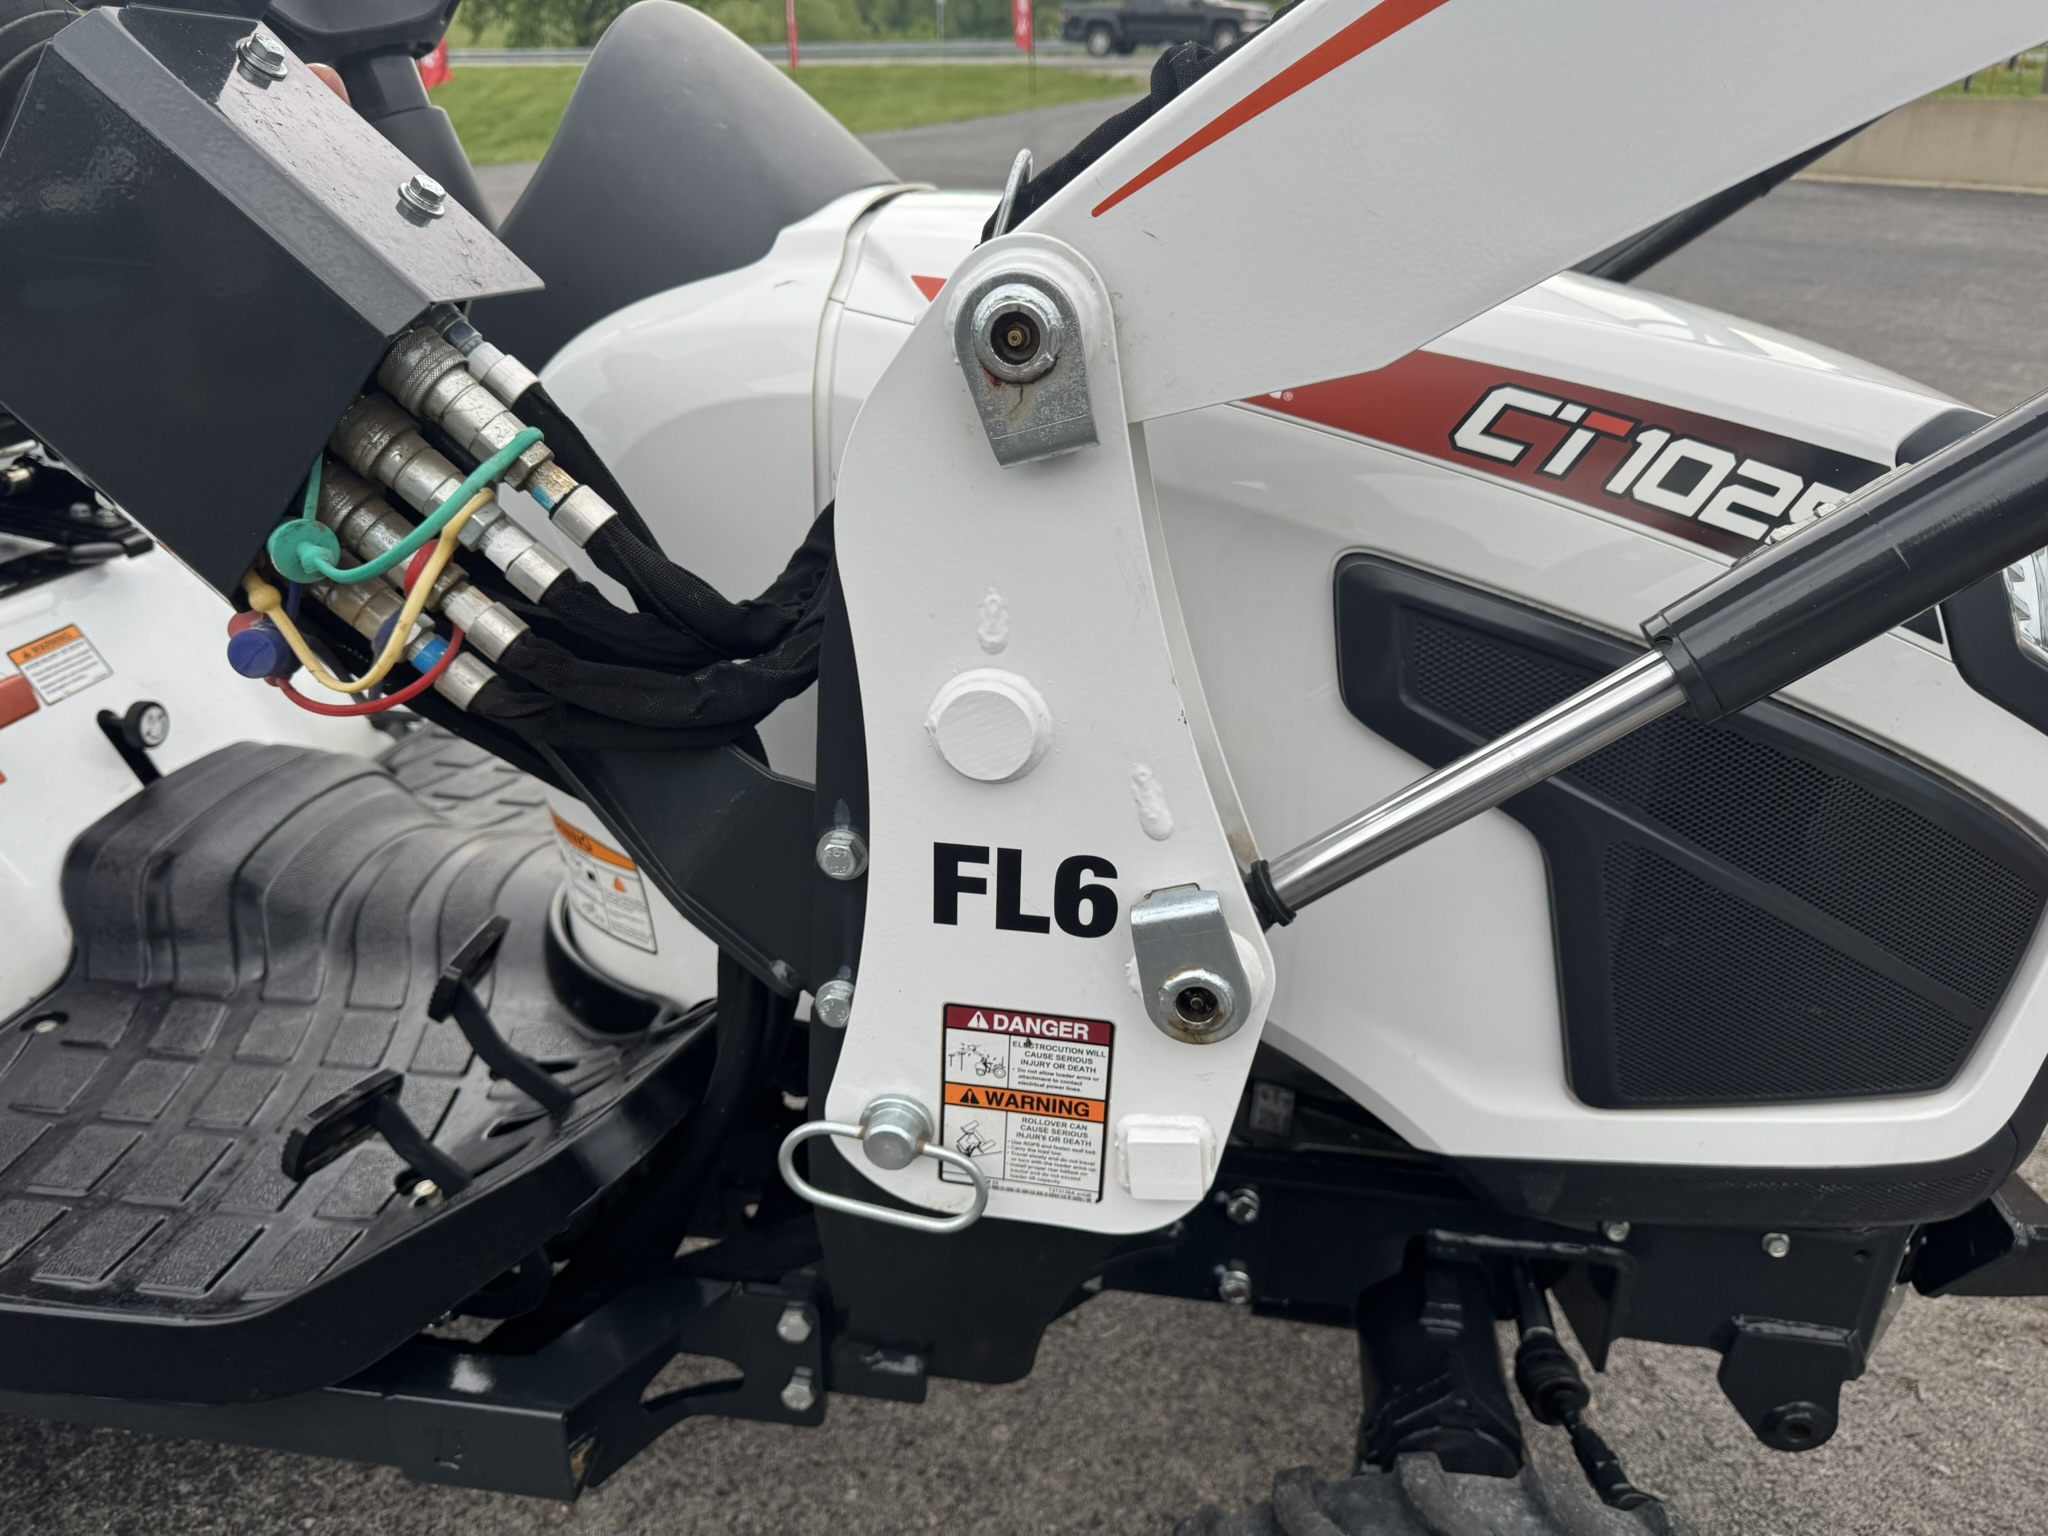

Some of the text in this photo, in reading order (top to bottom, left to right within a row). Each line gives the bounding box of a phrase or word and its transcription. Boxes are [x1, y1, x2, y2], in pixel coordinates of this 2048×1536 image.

[933, 842, 1118, 938] FL6
[993, 1014, 1089, 1040] DANGER
[1025, 1051, 1093, 1064] CAUSE SERIOUS
[1021, 1059, 1051, 1068] INJURY
[1068, 1064, 1096, 1073] DEATH
[1018, 1074, 1051, 1082] attachment
[985, 1090, 1090, 1118] WARNING
[1022, 1117, 1067, 1128] ROLLOVER
[1020, 1125, 1088, 1138] CAUSE SERIOUS
[1016, 1132, 1046, 1140] INJURY
[1063, 1137, 1091, 1146] DEATH
